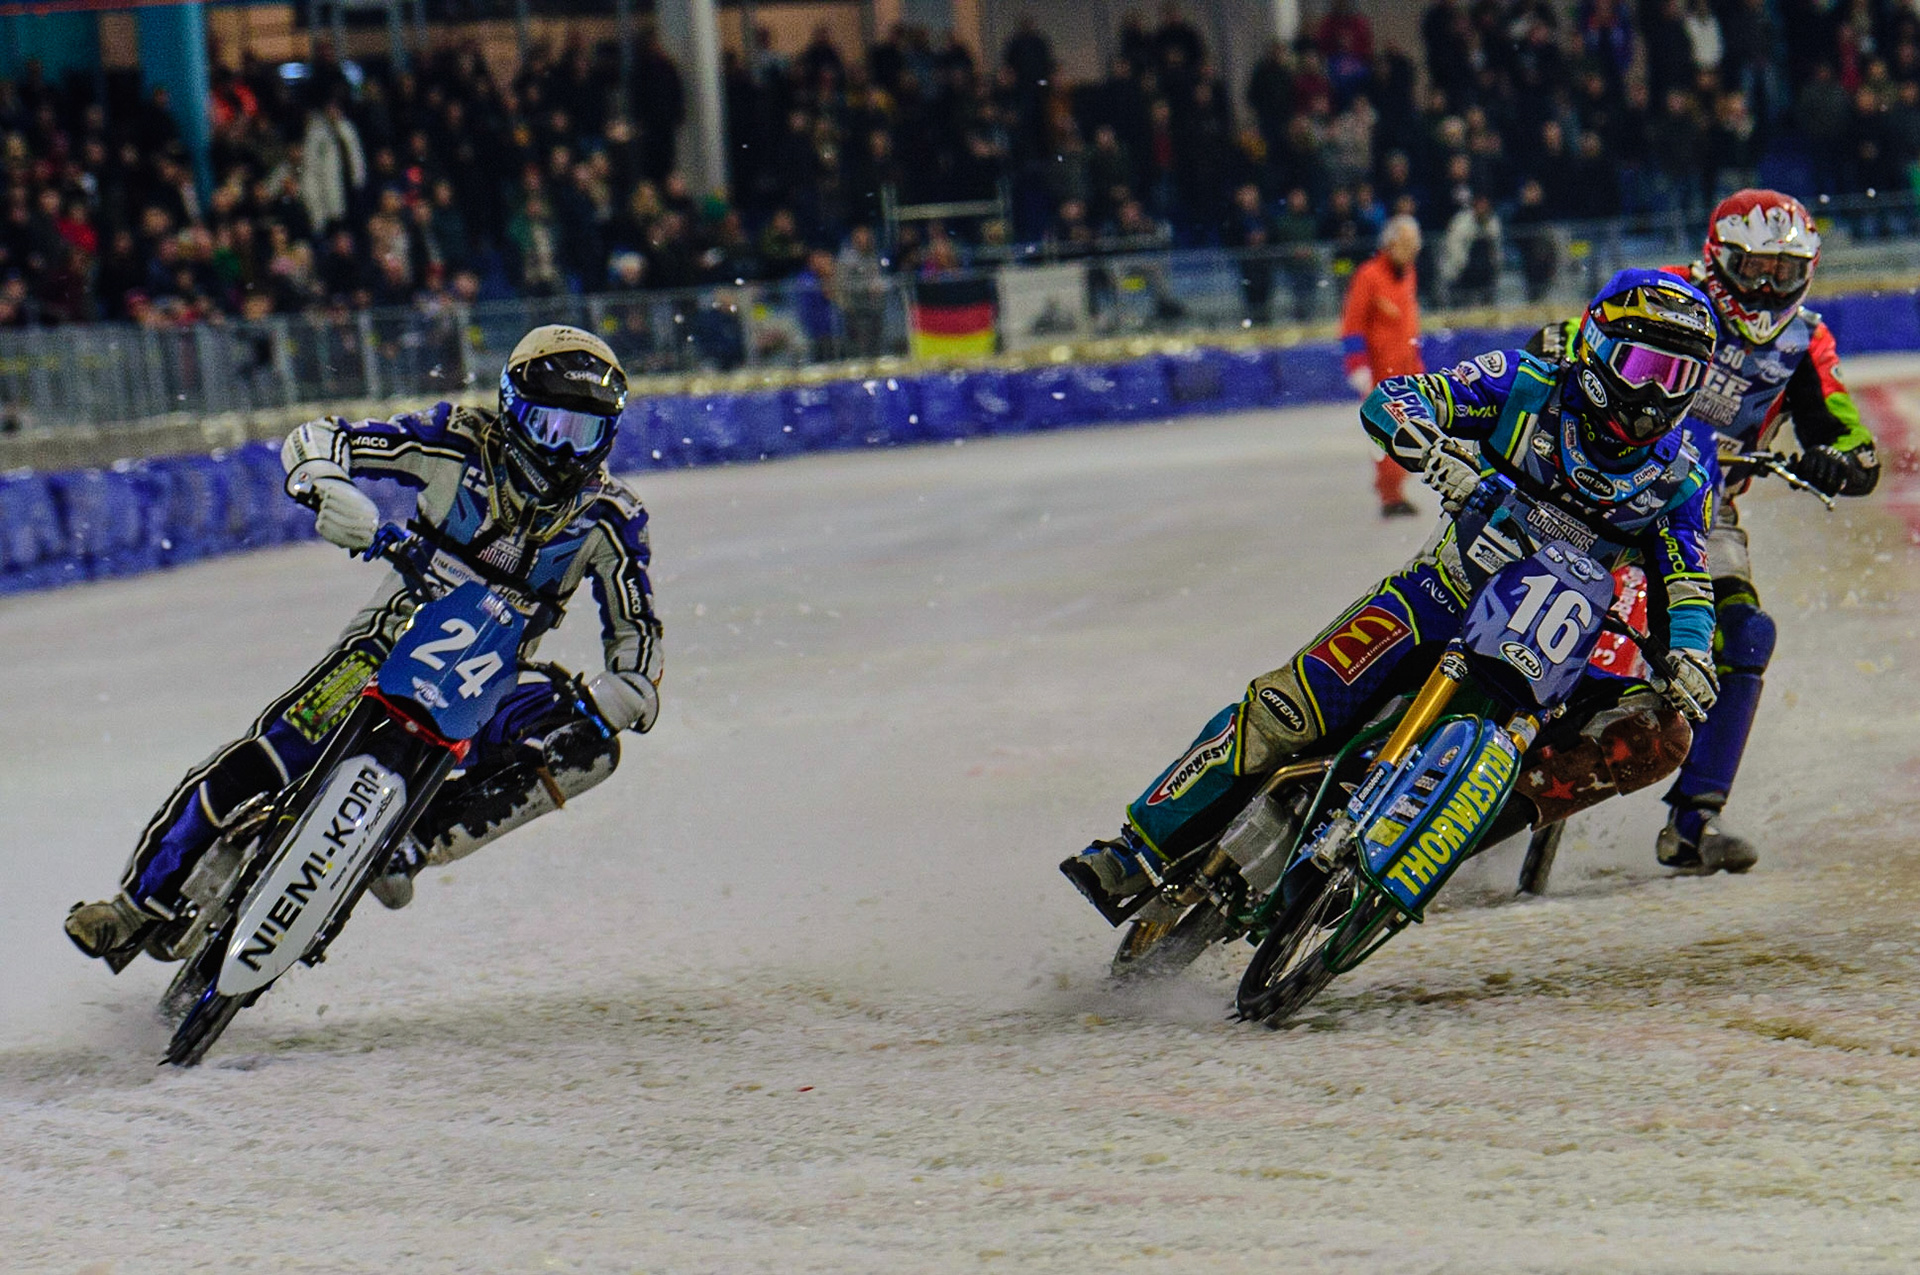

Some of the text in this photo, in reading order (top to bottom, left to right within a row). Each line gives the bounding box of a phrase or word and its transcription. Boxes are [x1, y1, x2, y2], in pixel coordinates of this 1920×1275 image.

[1585, 325, 1606, 352] FLY
[1719, 344, 1745, 370] 50
[351, 435, 389, 448] WACO
[1659, 527, 1687, 573] WACO
[626, 577, 642, 615] WACO
[1506, 573, 1593, 666] 16
[409, 617, 504, 700] 24
[1261, 689, 1304, 730] ORTEMA
[1386, 740, 1516, 896] THORWESTEN
